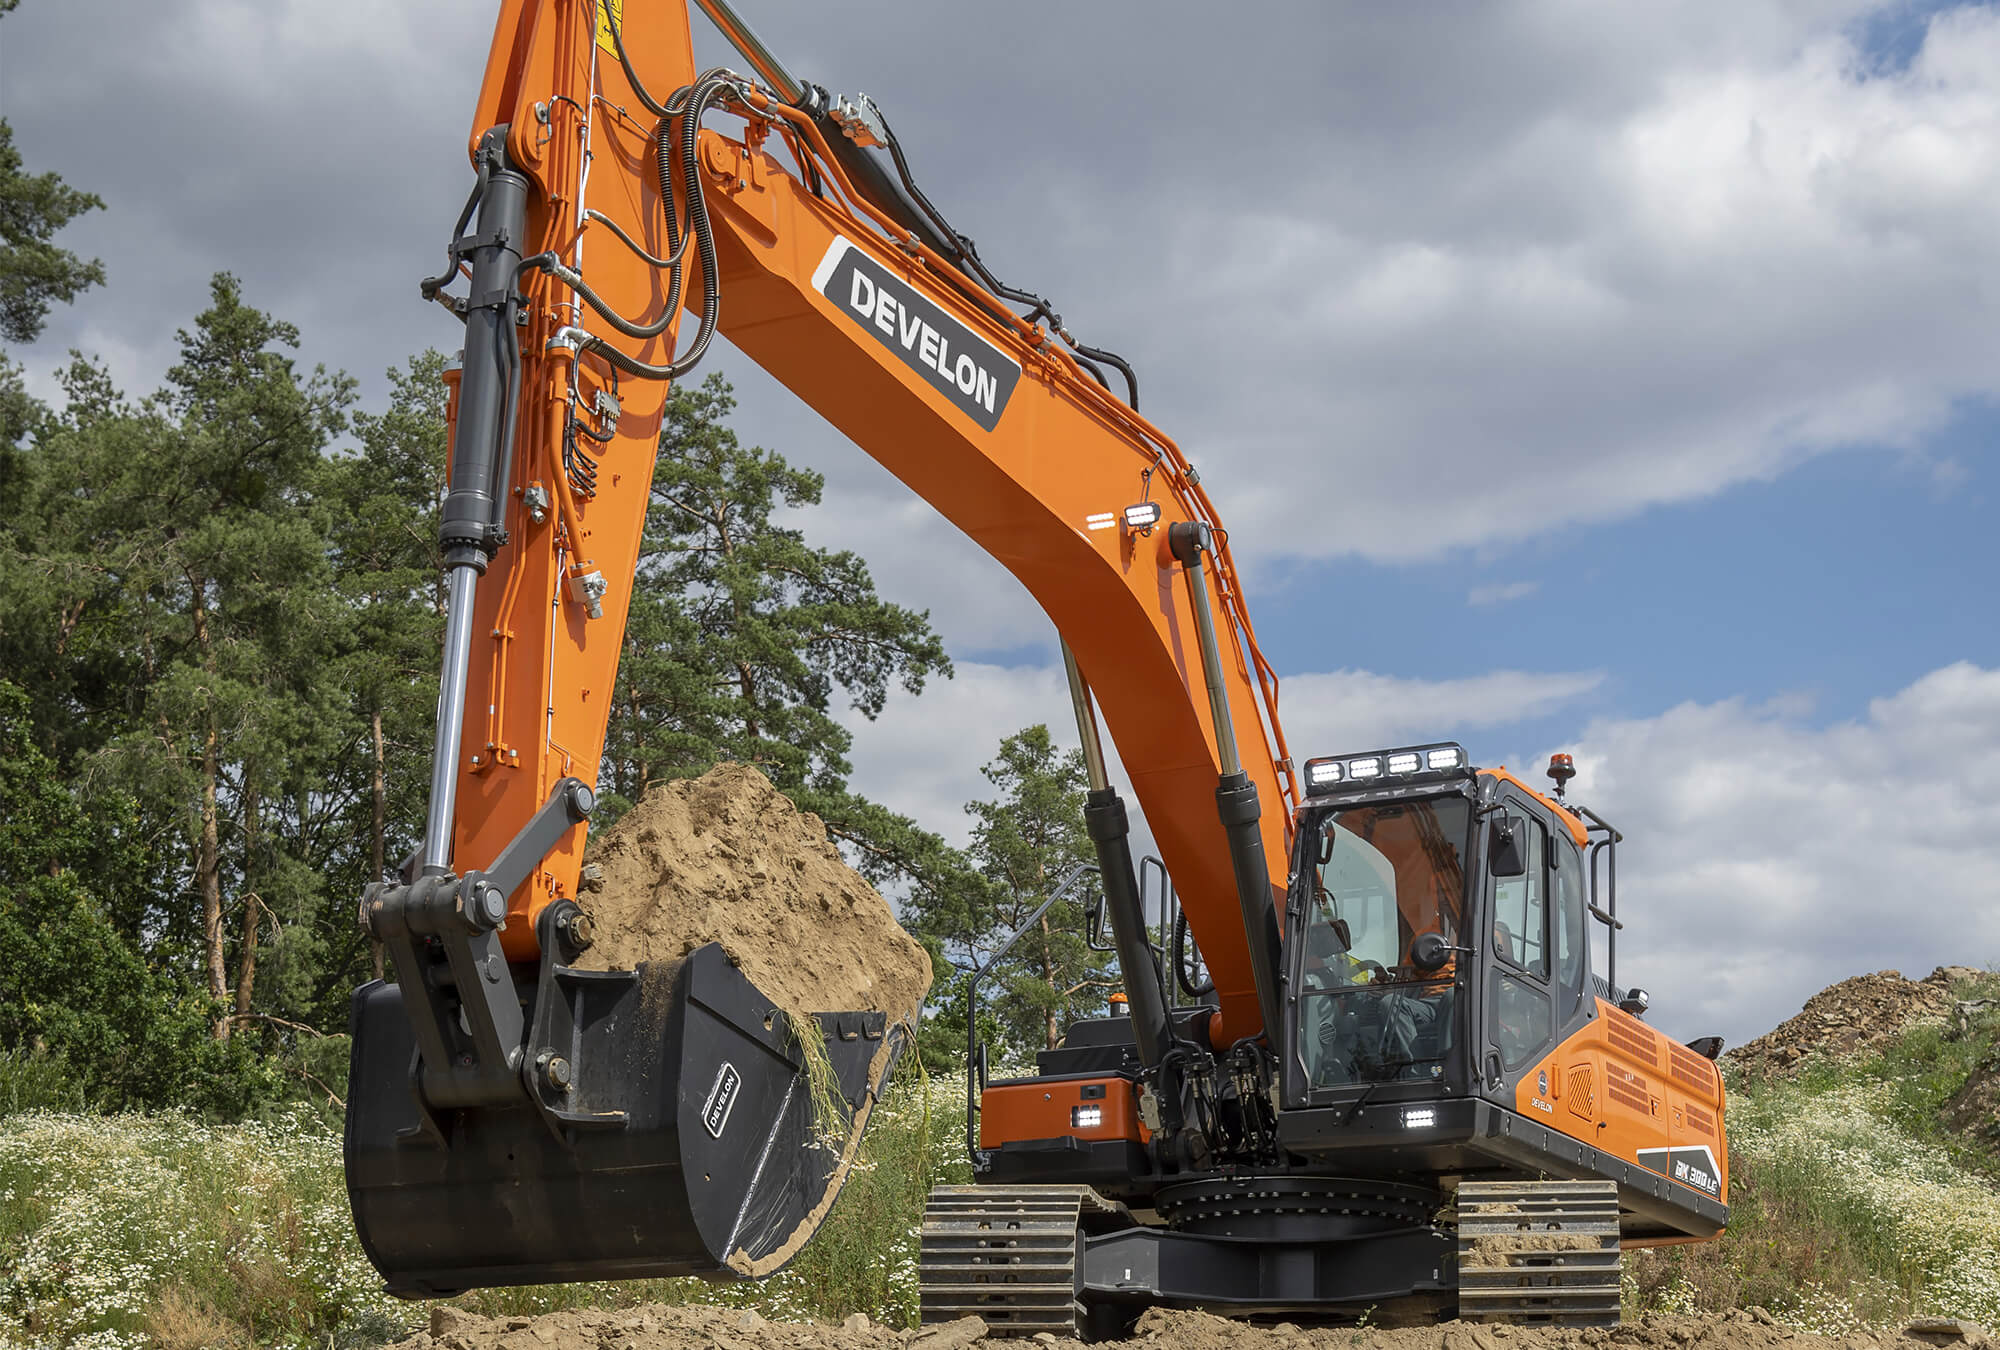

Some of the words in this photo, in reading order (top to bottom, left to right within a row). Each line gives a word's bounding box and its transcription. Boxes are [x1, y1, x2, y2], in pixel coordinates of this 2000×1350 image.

[850, 267, 997, 414] DEVELON
[710, 1074, 735, 1127] DEVELON
[1531, 1097, 1553, 1114] DEVELON
